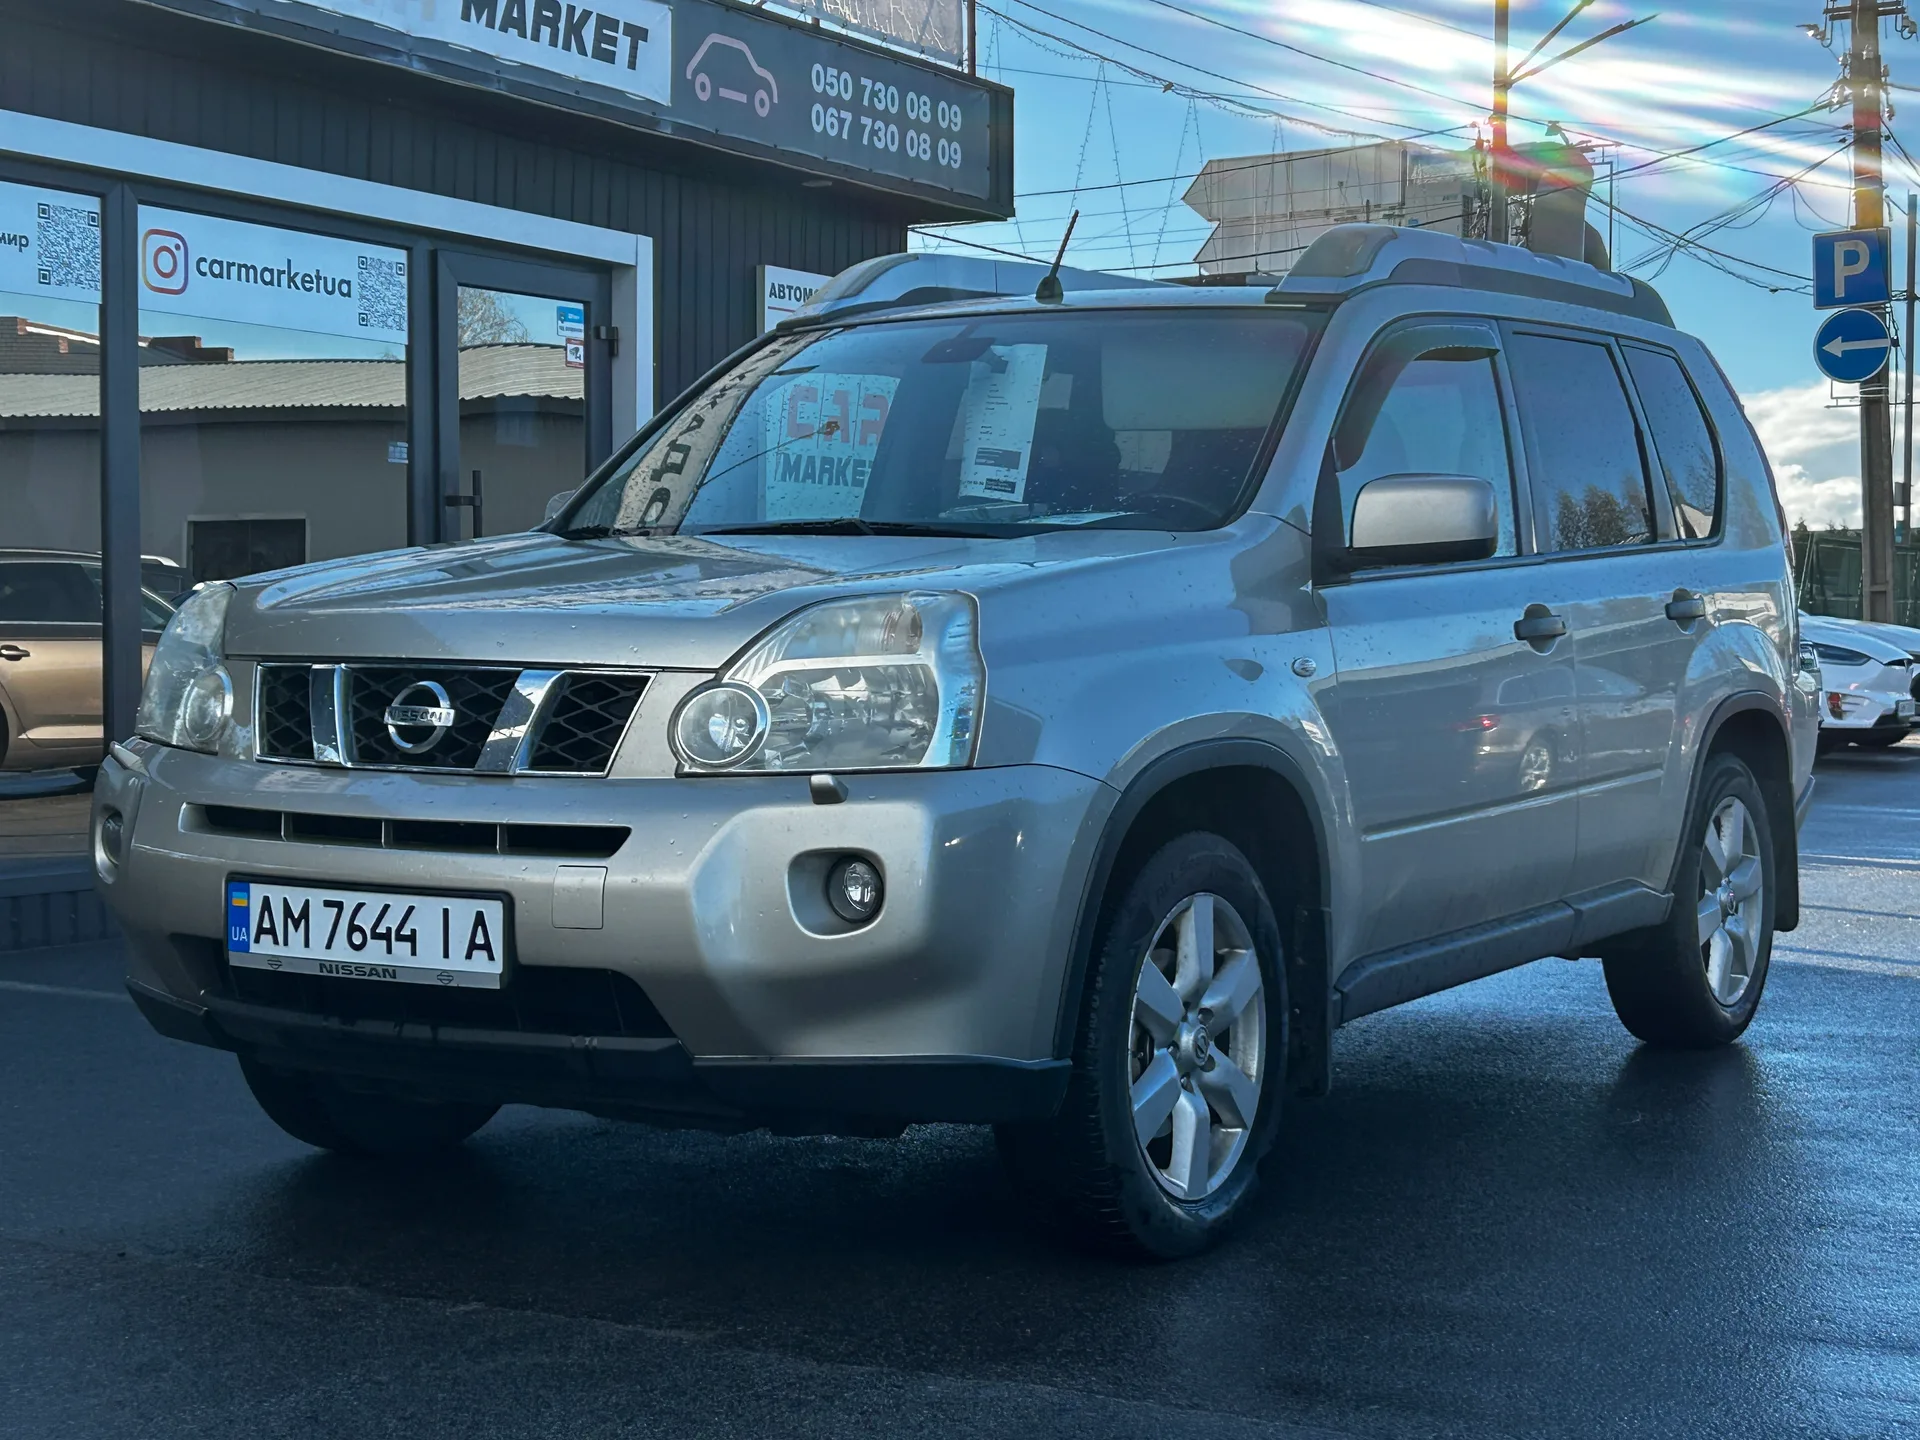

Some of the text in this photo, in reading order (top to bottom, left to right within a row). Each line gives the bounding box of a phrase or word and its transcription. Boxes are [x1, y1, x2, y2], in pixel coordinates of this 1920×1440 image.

[459, 0, 648, 71] MARKET
[811, 63, 962, 132] 050 730 08 09
[811, 103, 962, 169] 067 730 08 09
[195, 256, 352, 298] carmarketua
[768, 282, 819, 303] АВТОМ
[1834, 240, 1870, 298] P
[780, 452, 873, 489] MARKE
[231, 926, 248, 942] UA
[254, 895, 310, 948] AM
[323, 899, 417, 957] 7644
[318, 962, 397, 980] NISSAN
